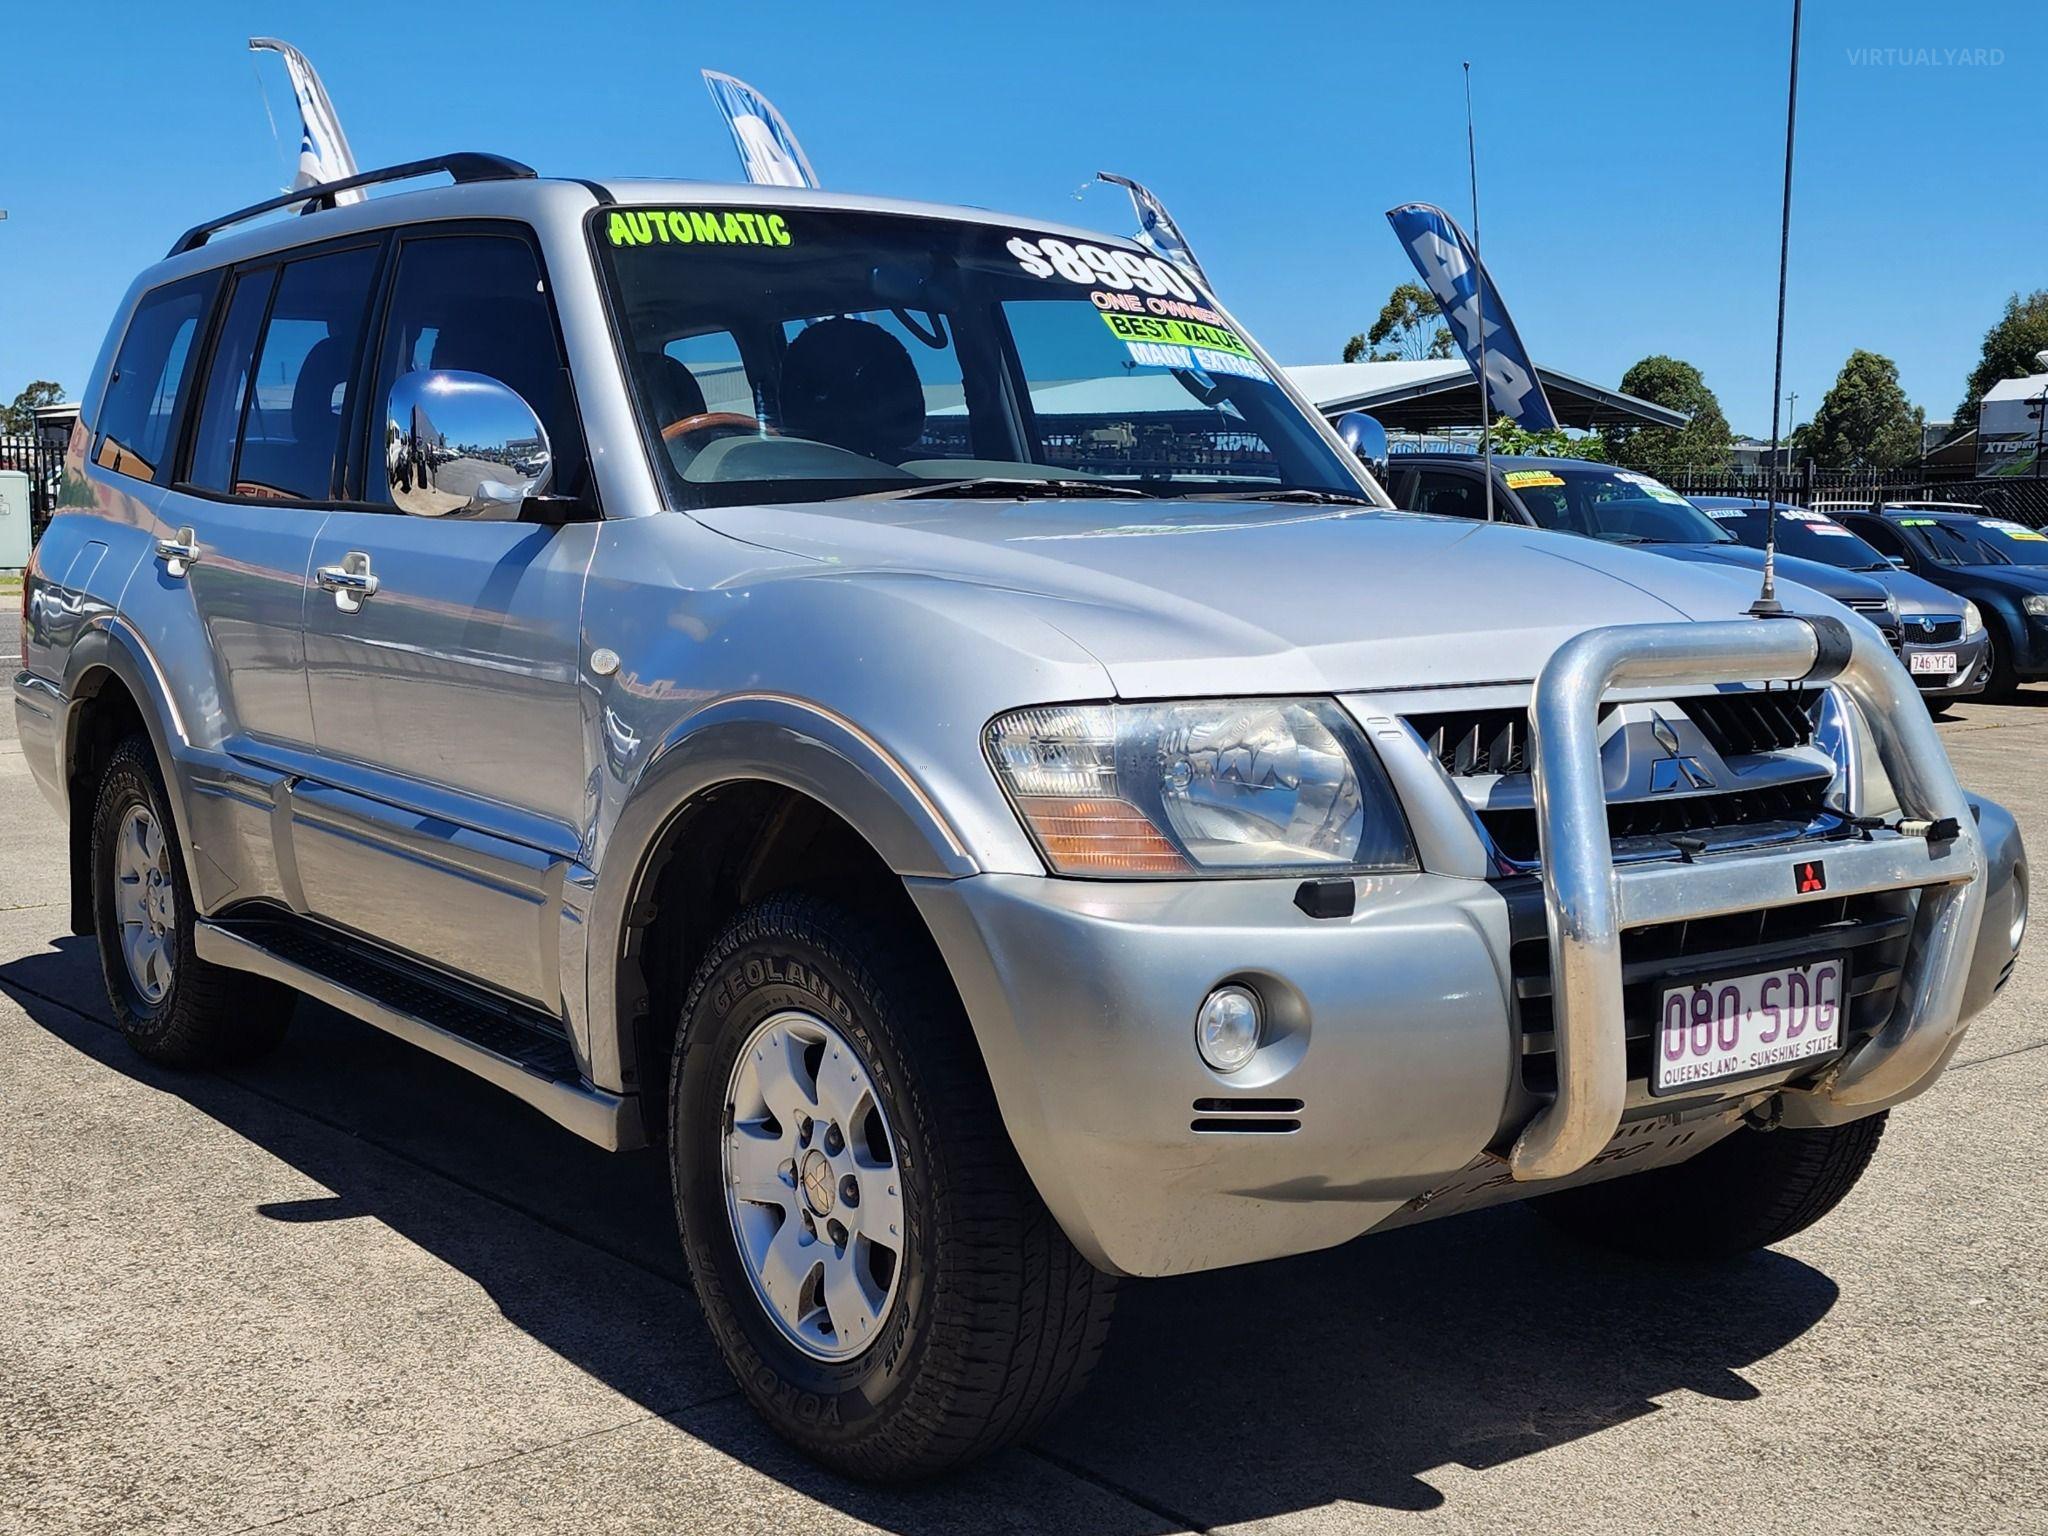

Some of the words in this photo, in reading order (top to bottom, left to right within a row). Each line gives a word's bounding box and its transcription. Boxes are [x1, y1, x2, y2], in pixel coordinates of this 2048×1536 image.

[609, 211, 792, 247] AUTOMATIC
[1006, 236, 1197, 303] $8990
[1090, 291, 1146, 313] ONE
[1146, 297, 1231, 331] OWNER
[1112, 316, 1173, 339] BEST
[1176, 321, 1246, 353] VALUE
[1126, 341, 1195, 369] MANY
[1191, 347, 1272, 385] EXTRAS
[711, 956, 895, 1098] GEOLANDAR
[1664, 1056, 1738, 1084] QUEENSLAND
[1750, 1041, 1801, 1068] SUNSHINE
